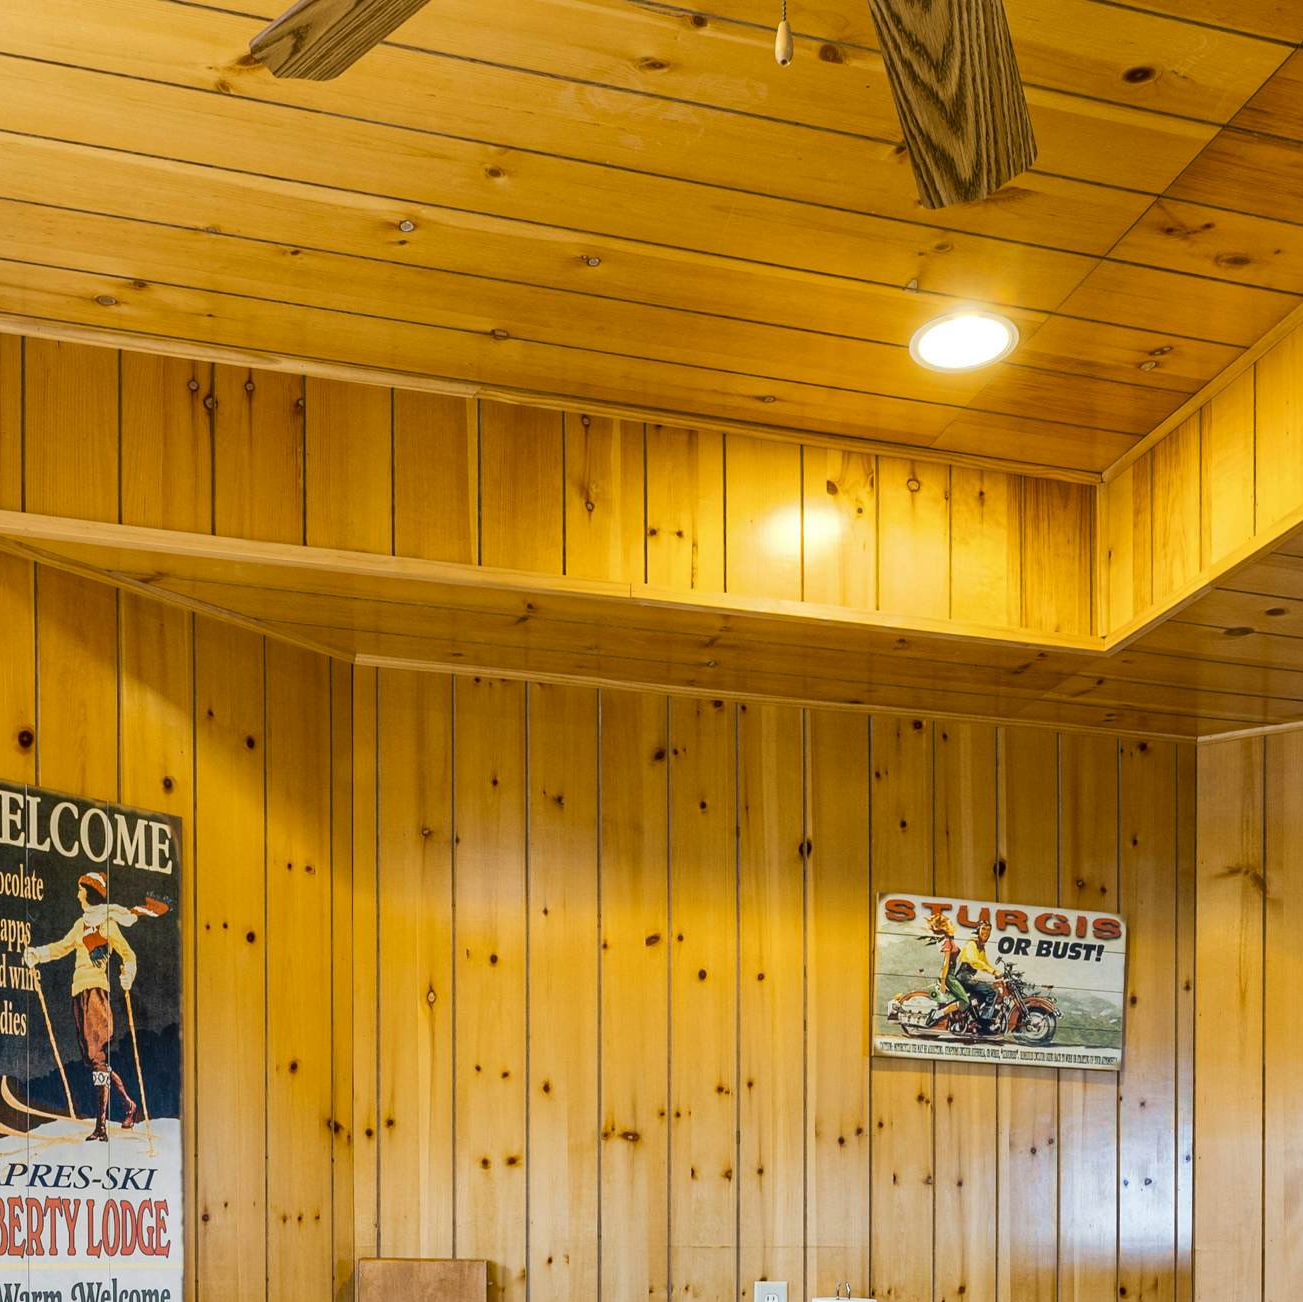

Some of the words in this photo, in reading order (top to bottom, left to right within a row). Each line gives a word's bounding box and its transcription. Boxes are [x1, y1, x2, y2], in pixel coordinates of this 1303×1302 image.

[885, 898, 1123, 940] STURGIS
[997, 936, 1032, 955] OR
[1035, 940, 1105, 962] BUST!
[9, 957, 41, 991] wine
[86, 1196, 171, 1259] LODGE
